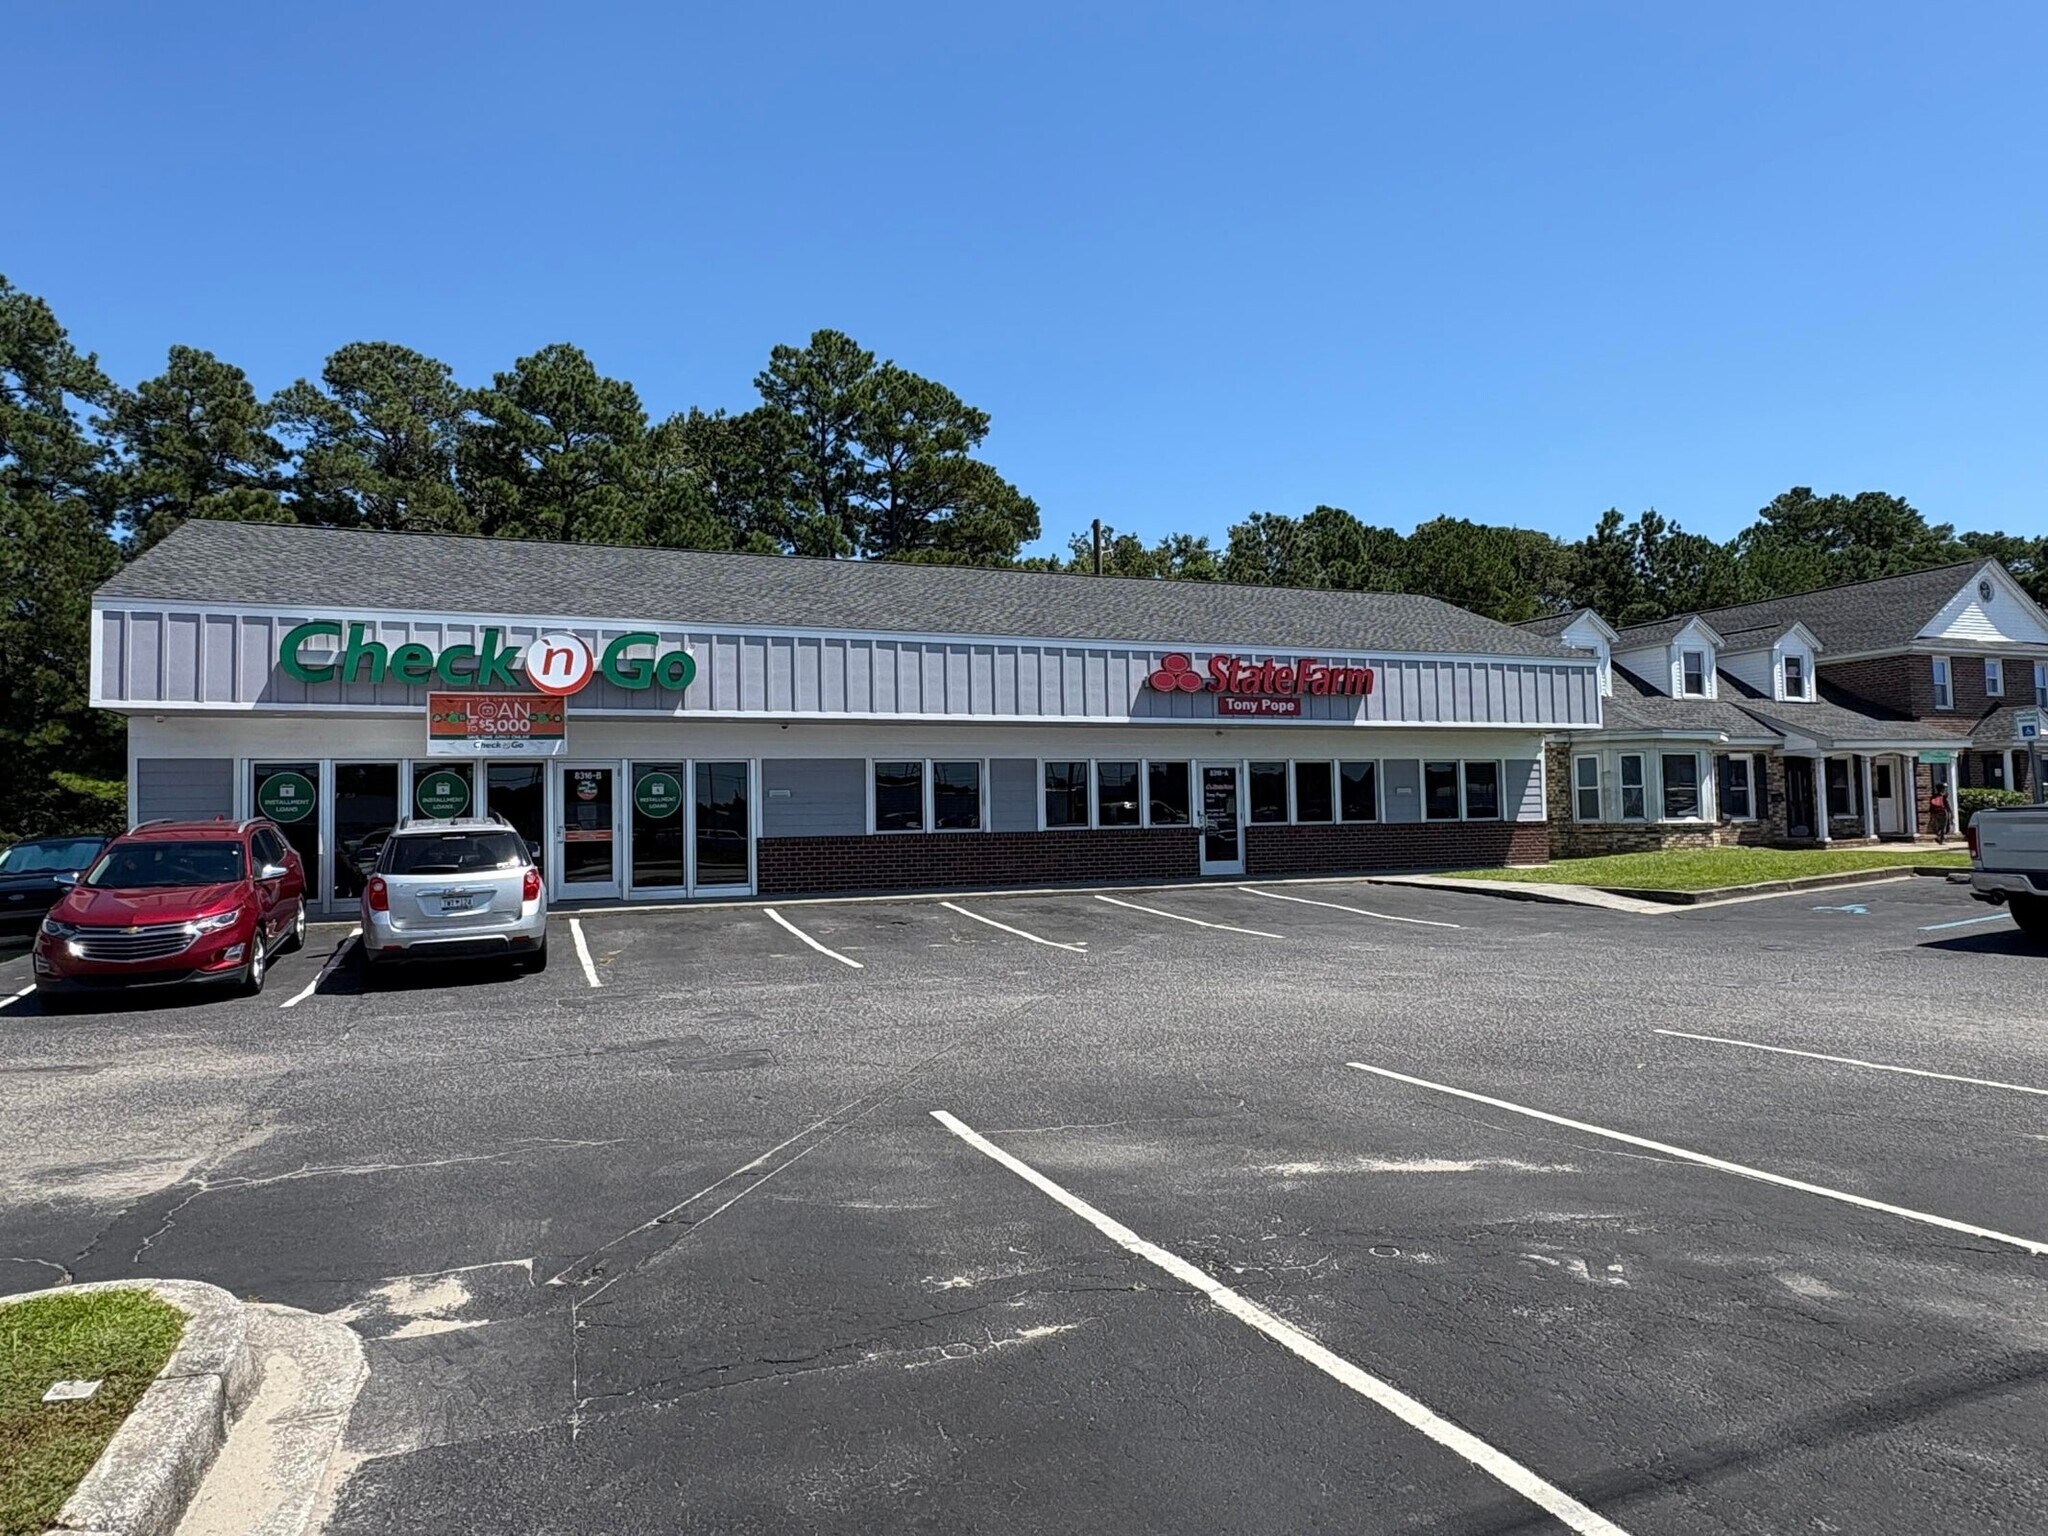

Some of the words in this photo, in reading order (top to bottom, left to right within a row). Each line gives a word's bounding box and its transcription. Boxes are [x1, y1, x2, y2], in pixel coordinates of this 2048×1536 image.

[280, 621, 523, 687] Check
[602, 632, 696, 691] Go
[466, 701, 531, 720] LOAN
[1225, 698, 1258, 712] Tony
[1262, 698, 1295, 712] Pope
[479, 719, 531, 734] $5,000
[473, 741, 501, 749] Check
[511, 741, 525, 749] Go
[574, 771, 603, 780] 8316-B
